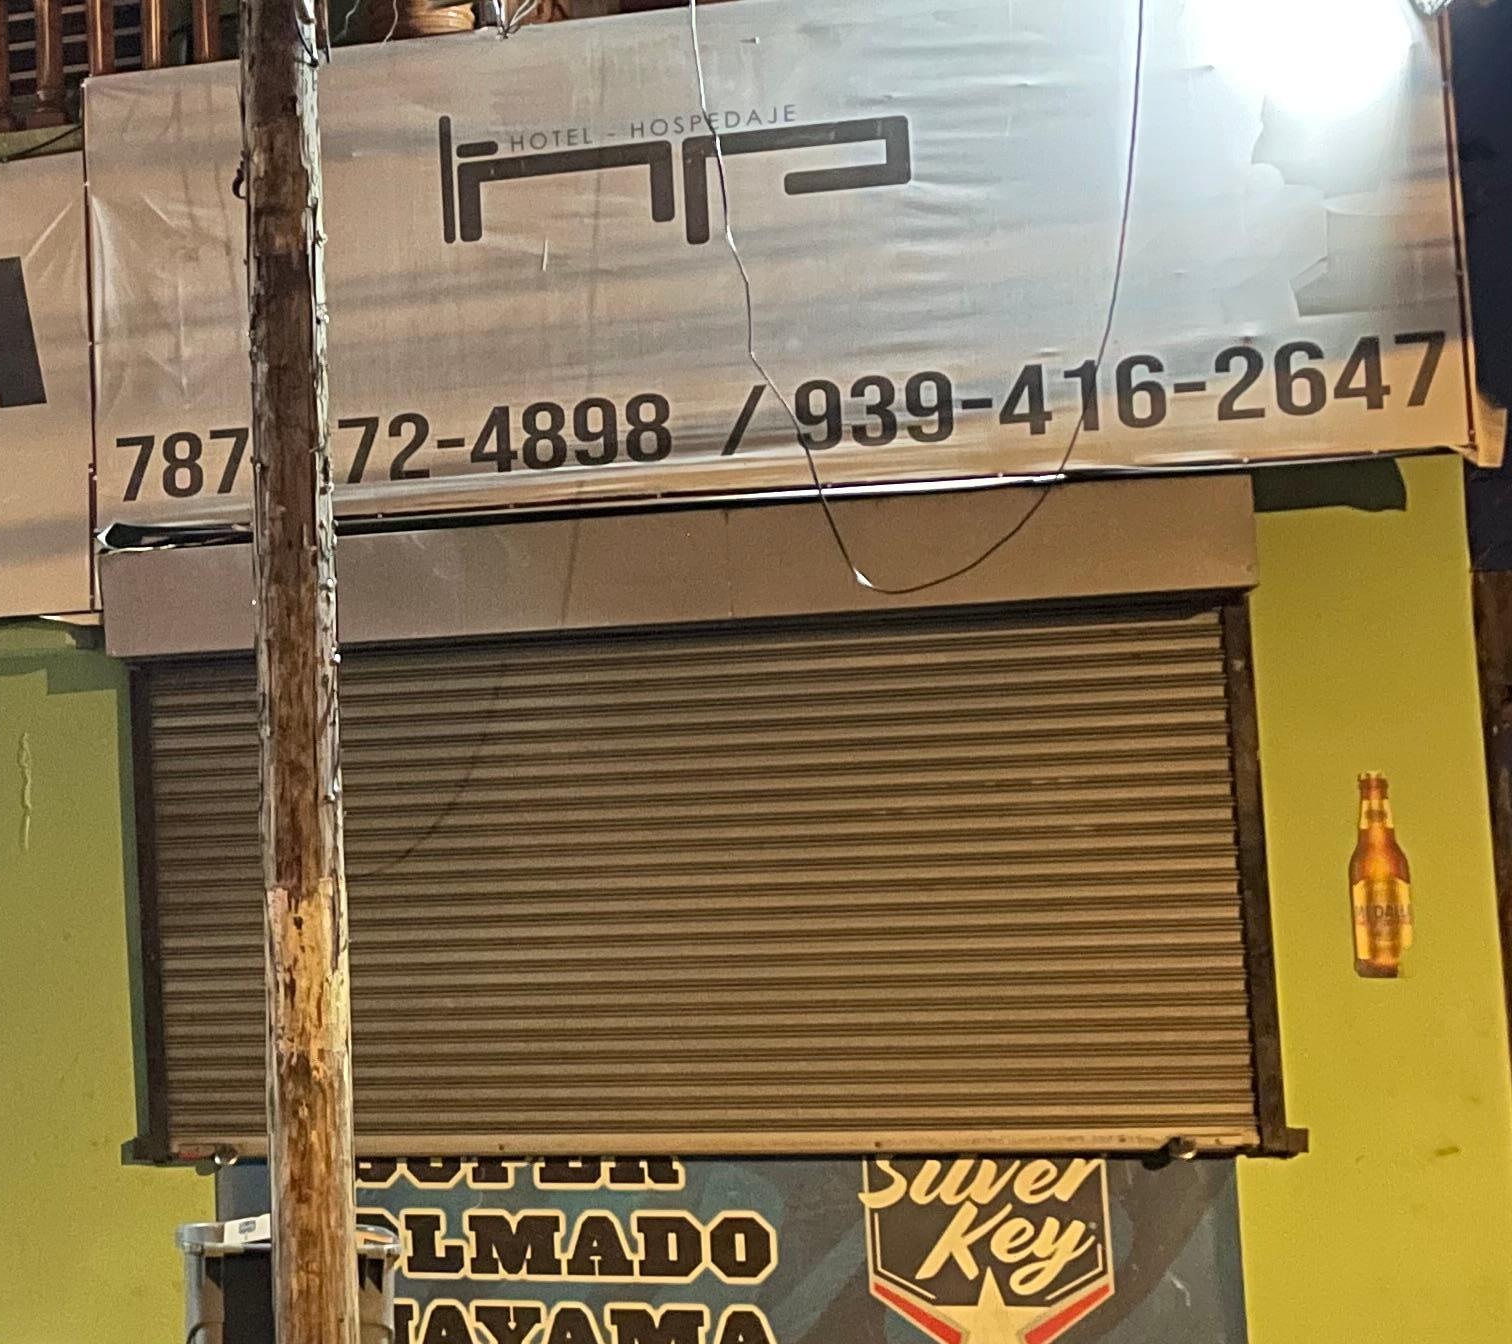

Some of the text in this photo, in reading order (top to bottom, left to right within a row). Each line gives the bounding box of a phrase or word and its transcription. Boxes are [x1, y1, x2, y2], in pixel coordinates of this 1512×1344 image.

[510, 128, 594, 154] HOTEL
[630, 104, 798, 139] HOSPEDAJE
[795, 332, 1446, 451] 939-416-2647
[356, 1207, 778, 1285] LMADO
[914, 1200, 1097, 1296] Key
